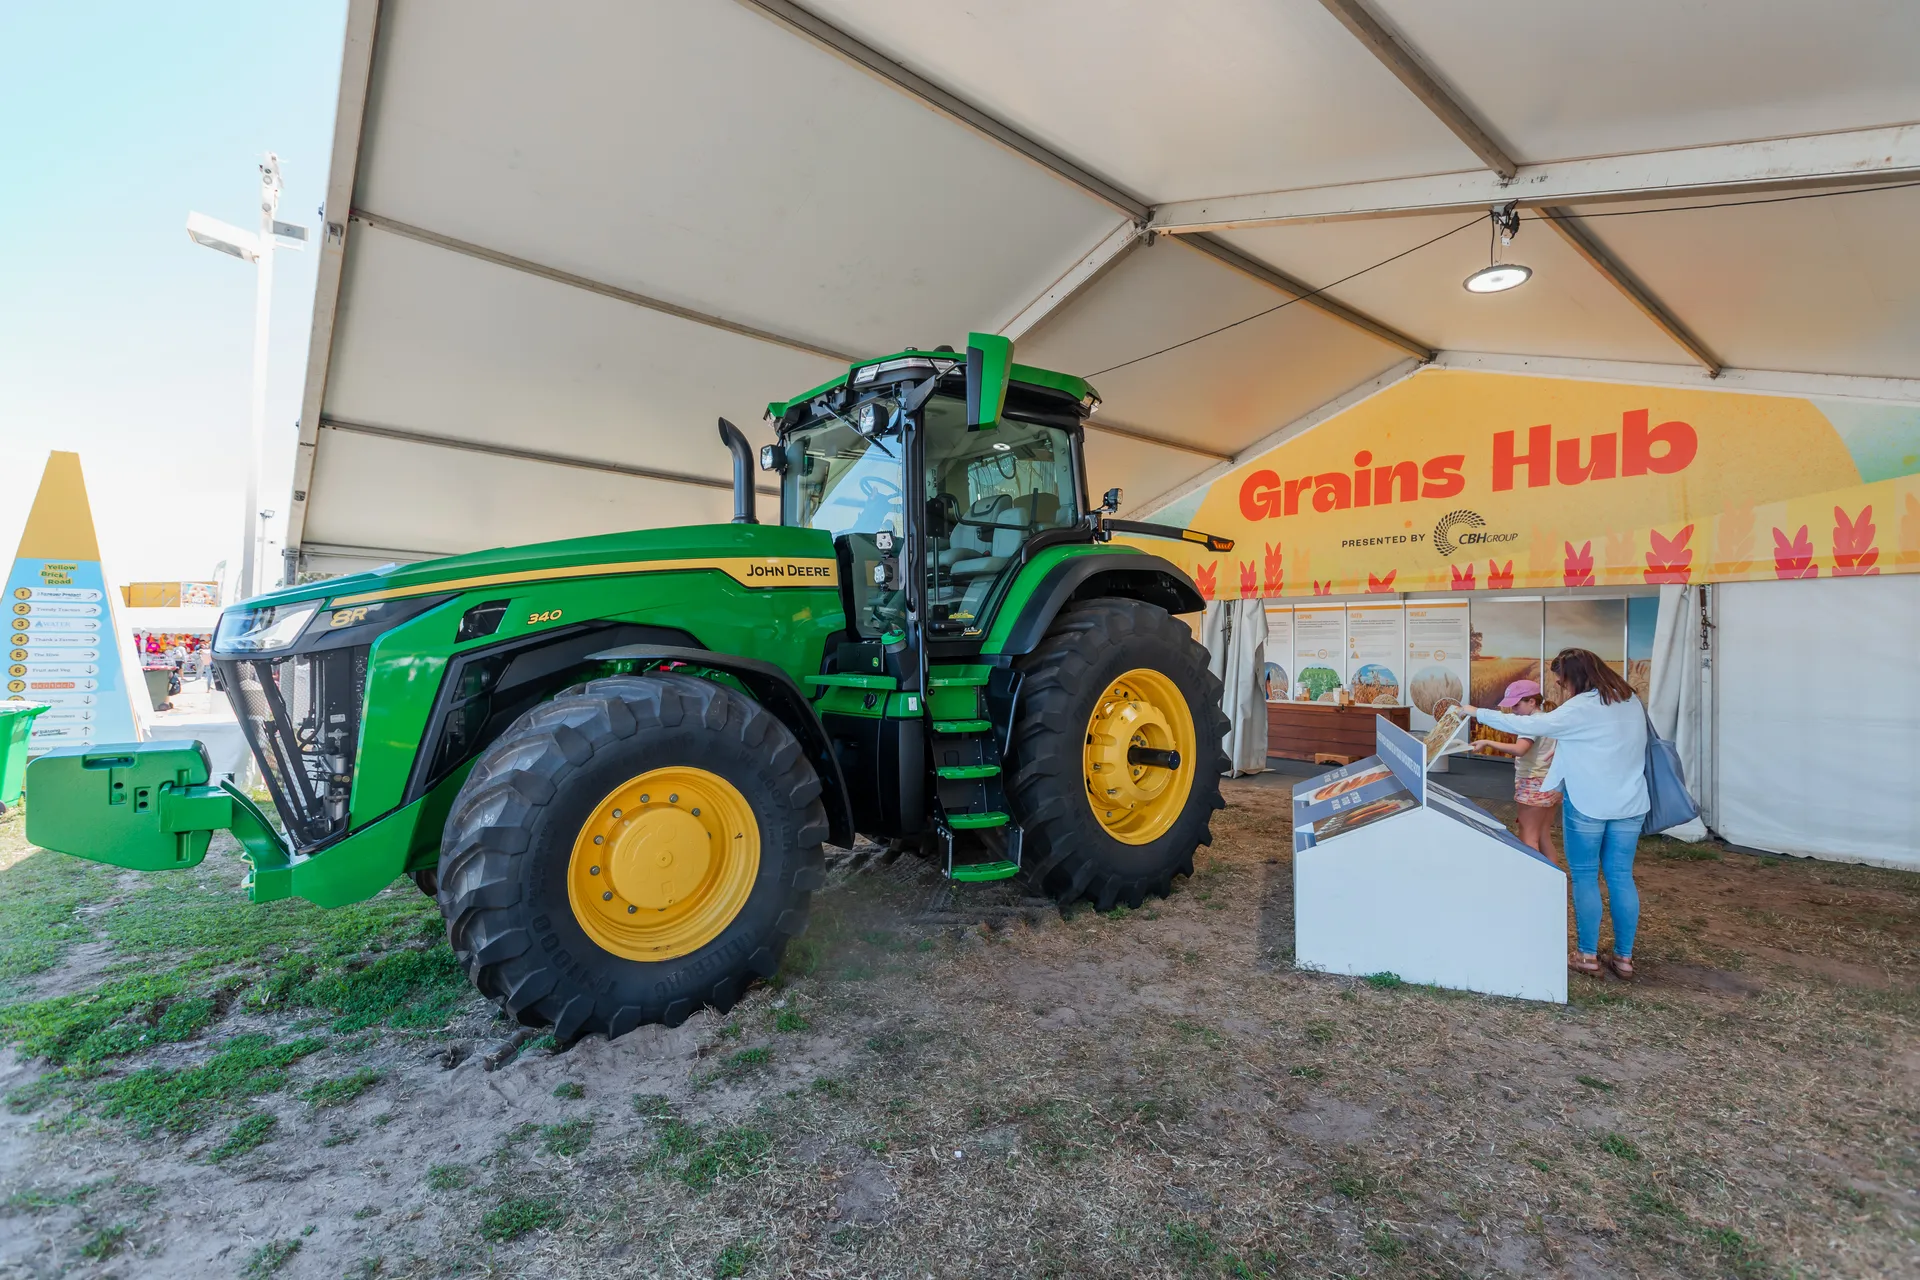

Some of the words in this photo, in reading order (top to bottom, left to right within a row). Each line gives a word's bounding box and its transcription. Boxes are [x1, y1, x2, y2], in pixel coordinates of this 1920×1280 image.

[1238, 449, 1466, 522] Grains
[1492, 408, 1699, 493] Hub
[1341, 535, 1407, 548] PRESENTED
[1410, 533, 1426, 543] BY
[40, 570, 64, 579] Brick
[746, 564, 785, 577] JOHN
[786, 564, 831, 577] DEERE
[330, 607, 368, 627] 8R
[527, 609, 563, 625] 340
